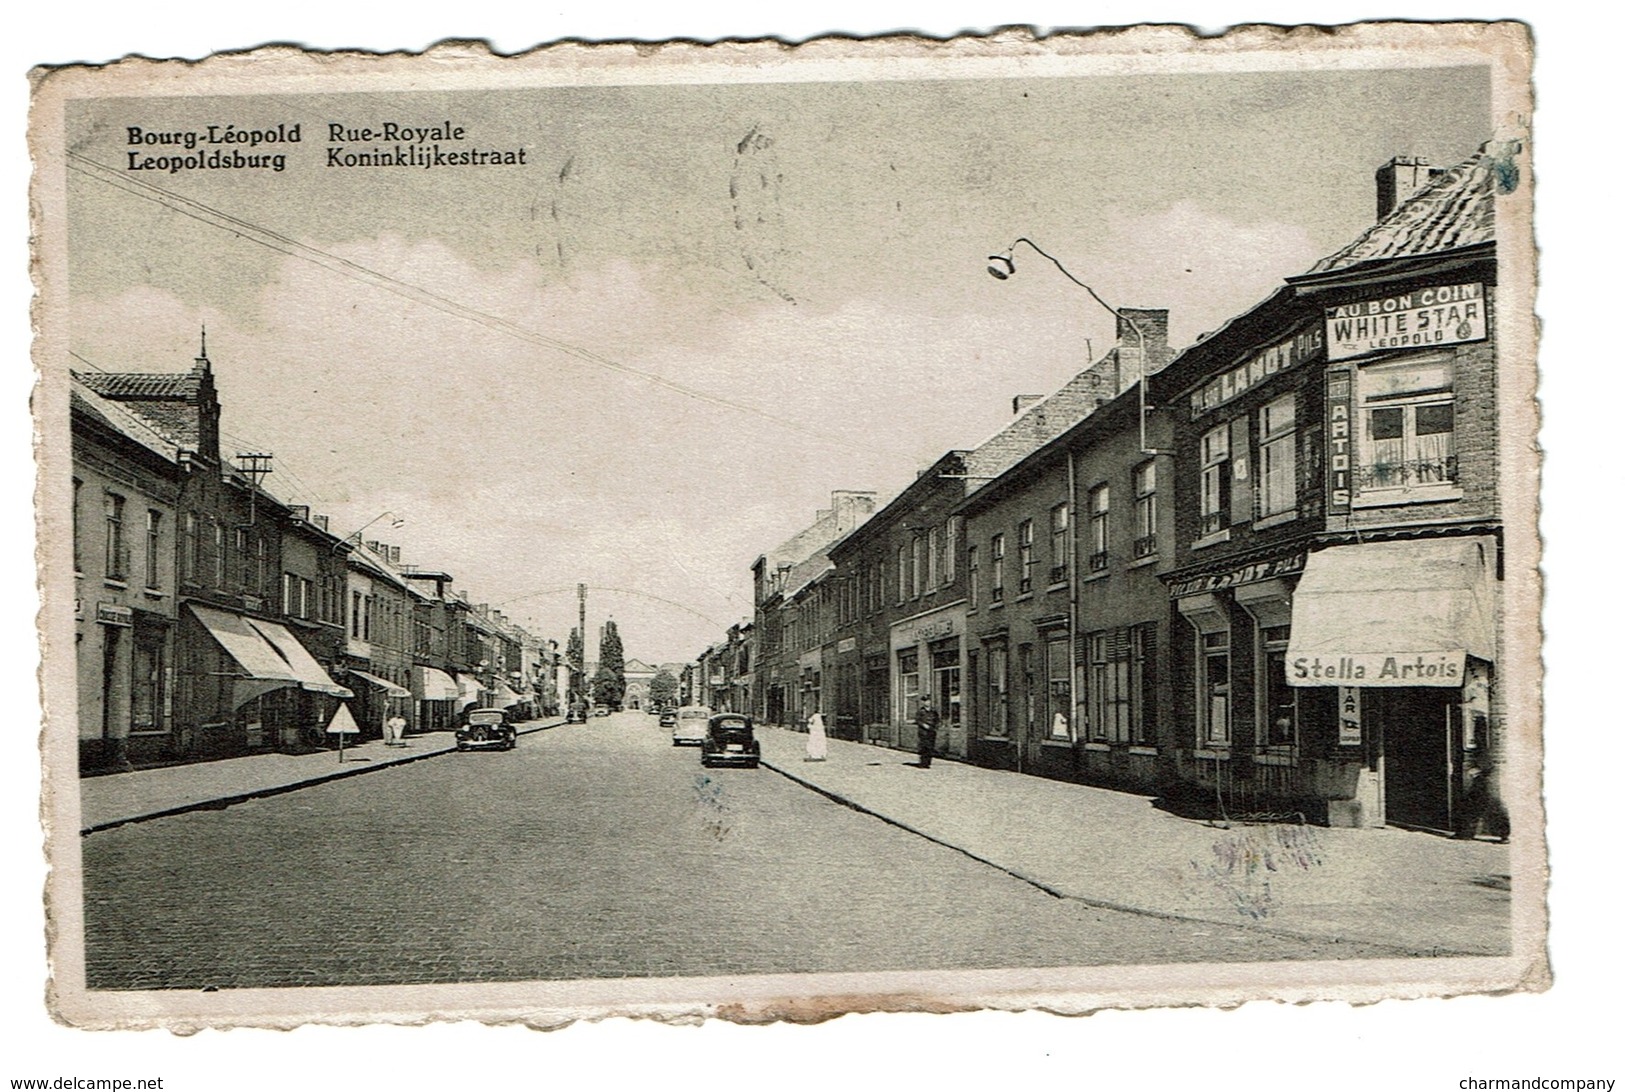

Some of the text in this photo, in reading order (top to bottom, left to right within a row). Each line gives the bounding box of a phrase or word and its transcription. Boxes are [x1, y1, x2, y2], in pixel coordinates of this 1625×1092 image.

[1335, 285, 1476, 319] AU BON COIN
[1334, 303, 1478, 343] WHITE STAR
[1297, 330, 1322, 360] PILS
[1369, 330, 1444, 349] LEOPOLD
[1332, 404, 1349, 507] ARTOIS
[1294, 656, 1459, 680] Stella Artois
[1343, 686, 1356, 713] TAR
